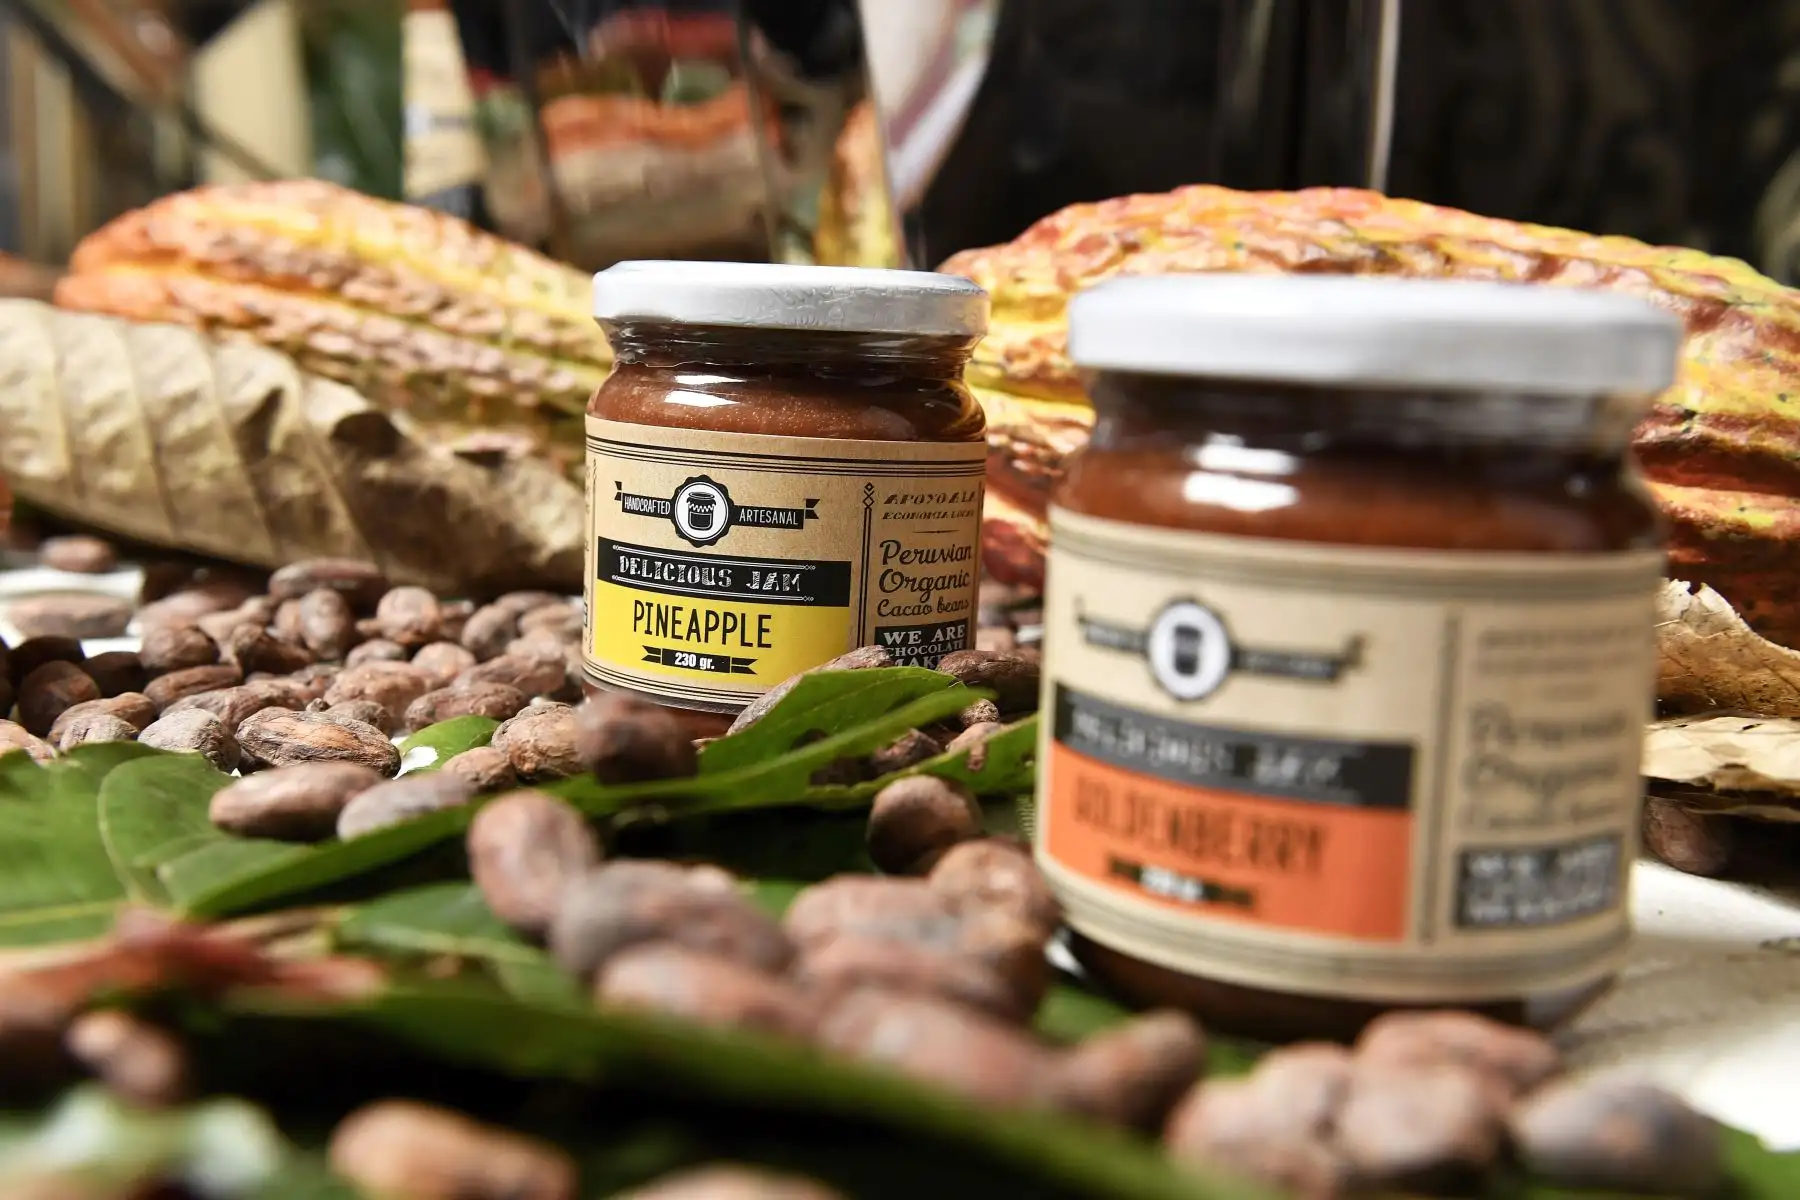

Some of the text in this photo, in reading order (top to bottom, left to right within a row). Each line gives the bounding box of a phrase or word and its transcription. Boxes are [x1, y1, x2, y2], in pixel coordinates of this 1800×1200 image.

[624, 495, 671, 516] HANDCRAFTED
[883, 492, 946, 505] APOYO
[739, 509, 798, 526] ARTESANAL
[879, 539, 972, 566] Peruvian
[618, 554, 801, 592] DELICIOUS JAM
[878, 568, 970, 603] Organic
[877, 596, 970, 617] Cacao beans
[633, 599, 773, 648] PINEAPPLE
[883, 624, 966, 646] WE ARE
[674, 652, 715, 671] 230 gr.
